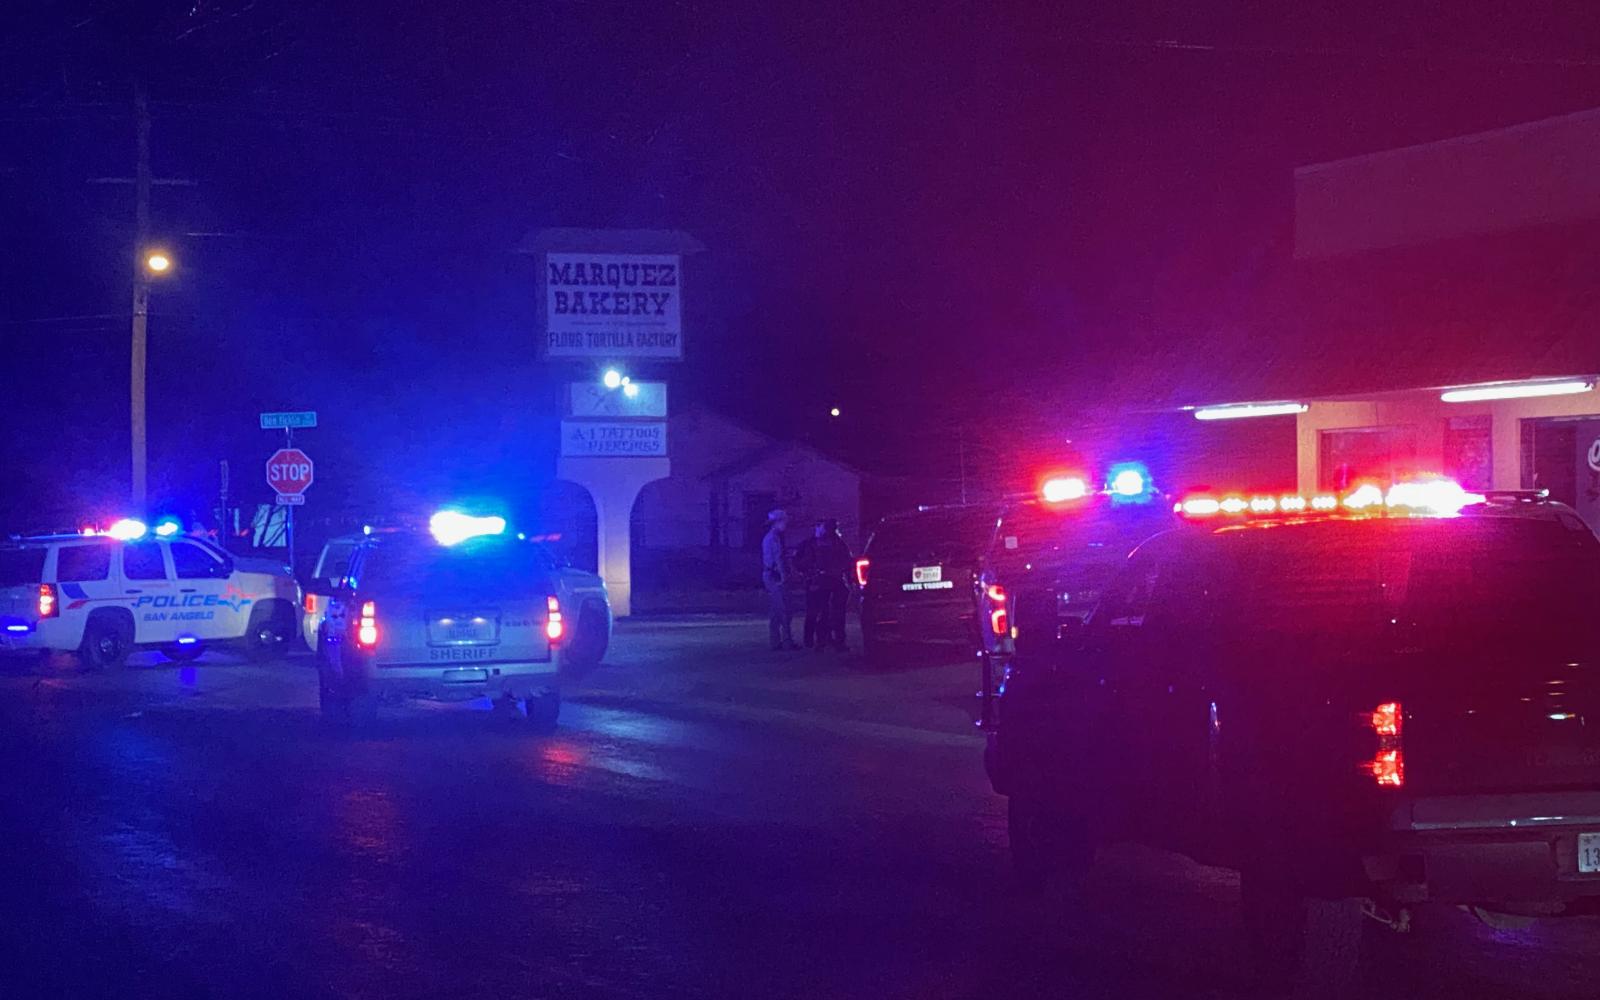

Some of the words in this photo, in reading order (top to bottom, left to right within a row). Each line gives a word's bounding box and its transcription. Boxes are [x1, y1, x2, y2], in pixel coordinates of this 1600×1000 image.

[550, 263, 676, 288] MARQUEZ
[554, 291, 670, 315] BAKERY
[549, 332, 583, 347] FLOUR
[586, 332, 634, 347] TORTILLA
[637, 332, 677, 347] FACTORY
[599, 427, 660, 439] TATTOOS
[270, 464, 310, 481] STOP
[136, 594, 219, 608] POLICE
[144, 612, 167, 622] SAN
[170, 611, 214, 621] ANGELO
[430, 649, 497, 660] SHERIFF
